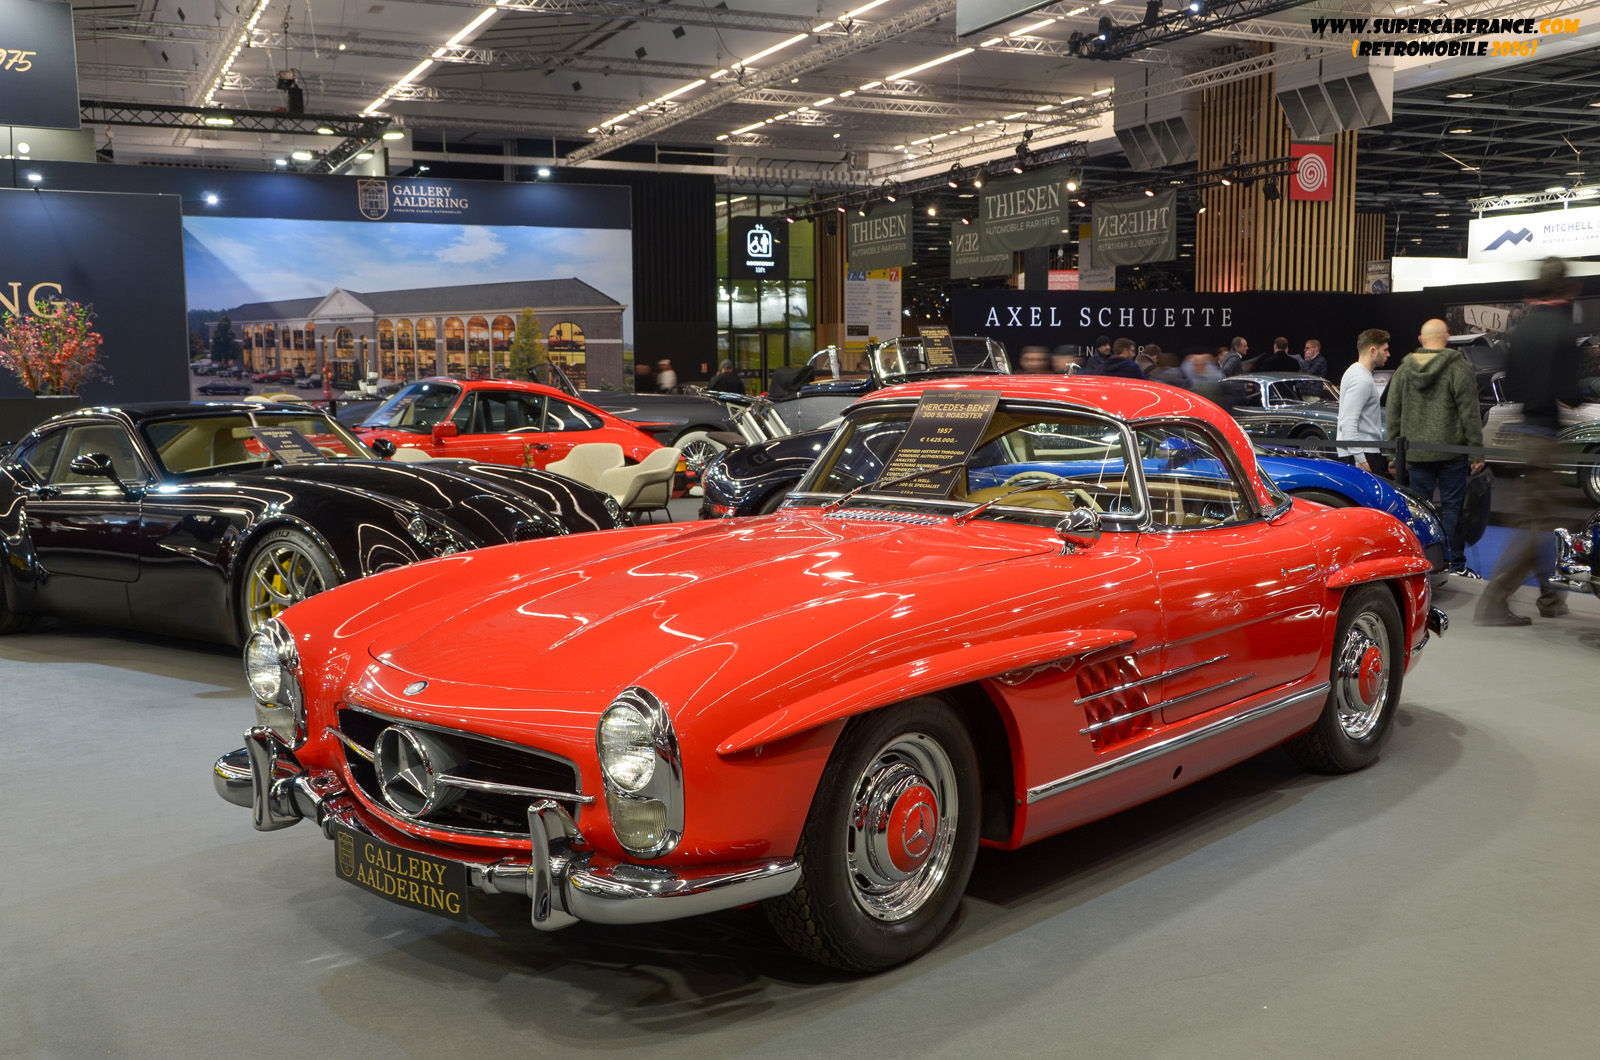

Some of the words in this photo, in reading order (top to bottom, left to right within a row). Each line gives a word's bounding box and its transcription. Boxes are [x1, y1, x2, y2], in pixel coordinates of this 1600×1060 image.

[392, 185, 452, 197] GALLERY
[393, 196, 468, 209] AALDERING
[985, 183, 1060, 219] THIESEN
[852, 214, 906, 243] THIESEN
[986, 222, 1024, 235] AUTOMOBILE
[1025, 216, 1060, 229] RARITÄTEN
[1544, 221, 1593, 234] MITCHELL
[985, 307, 1062, 326] AXEL
[1080, 307, 1232, 327] SCHUETTE
[921, 404, 990, 412] MERCEDES-BENZ
[365, 843, 447, 885] GALLERY
[356, 863, 460, 914] AALDERING
